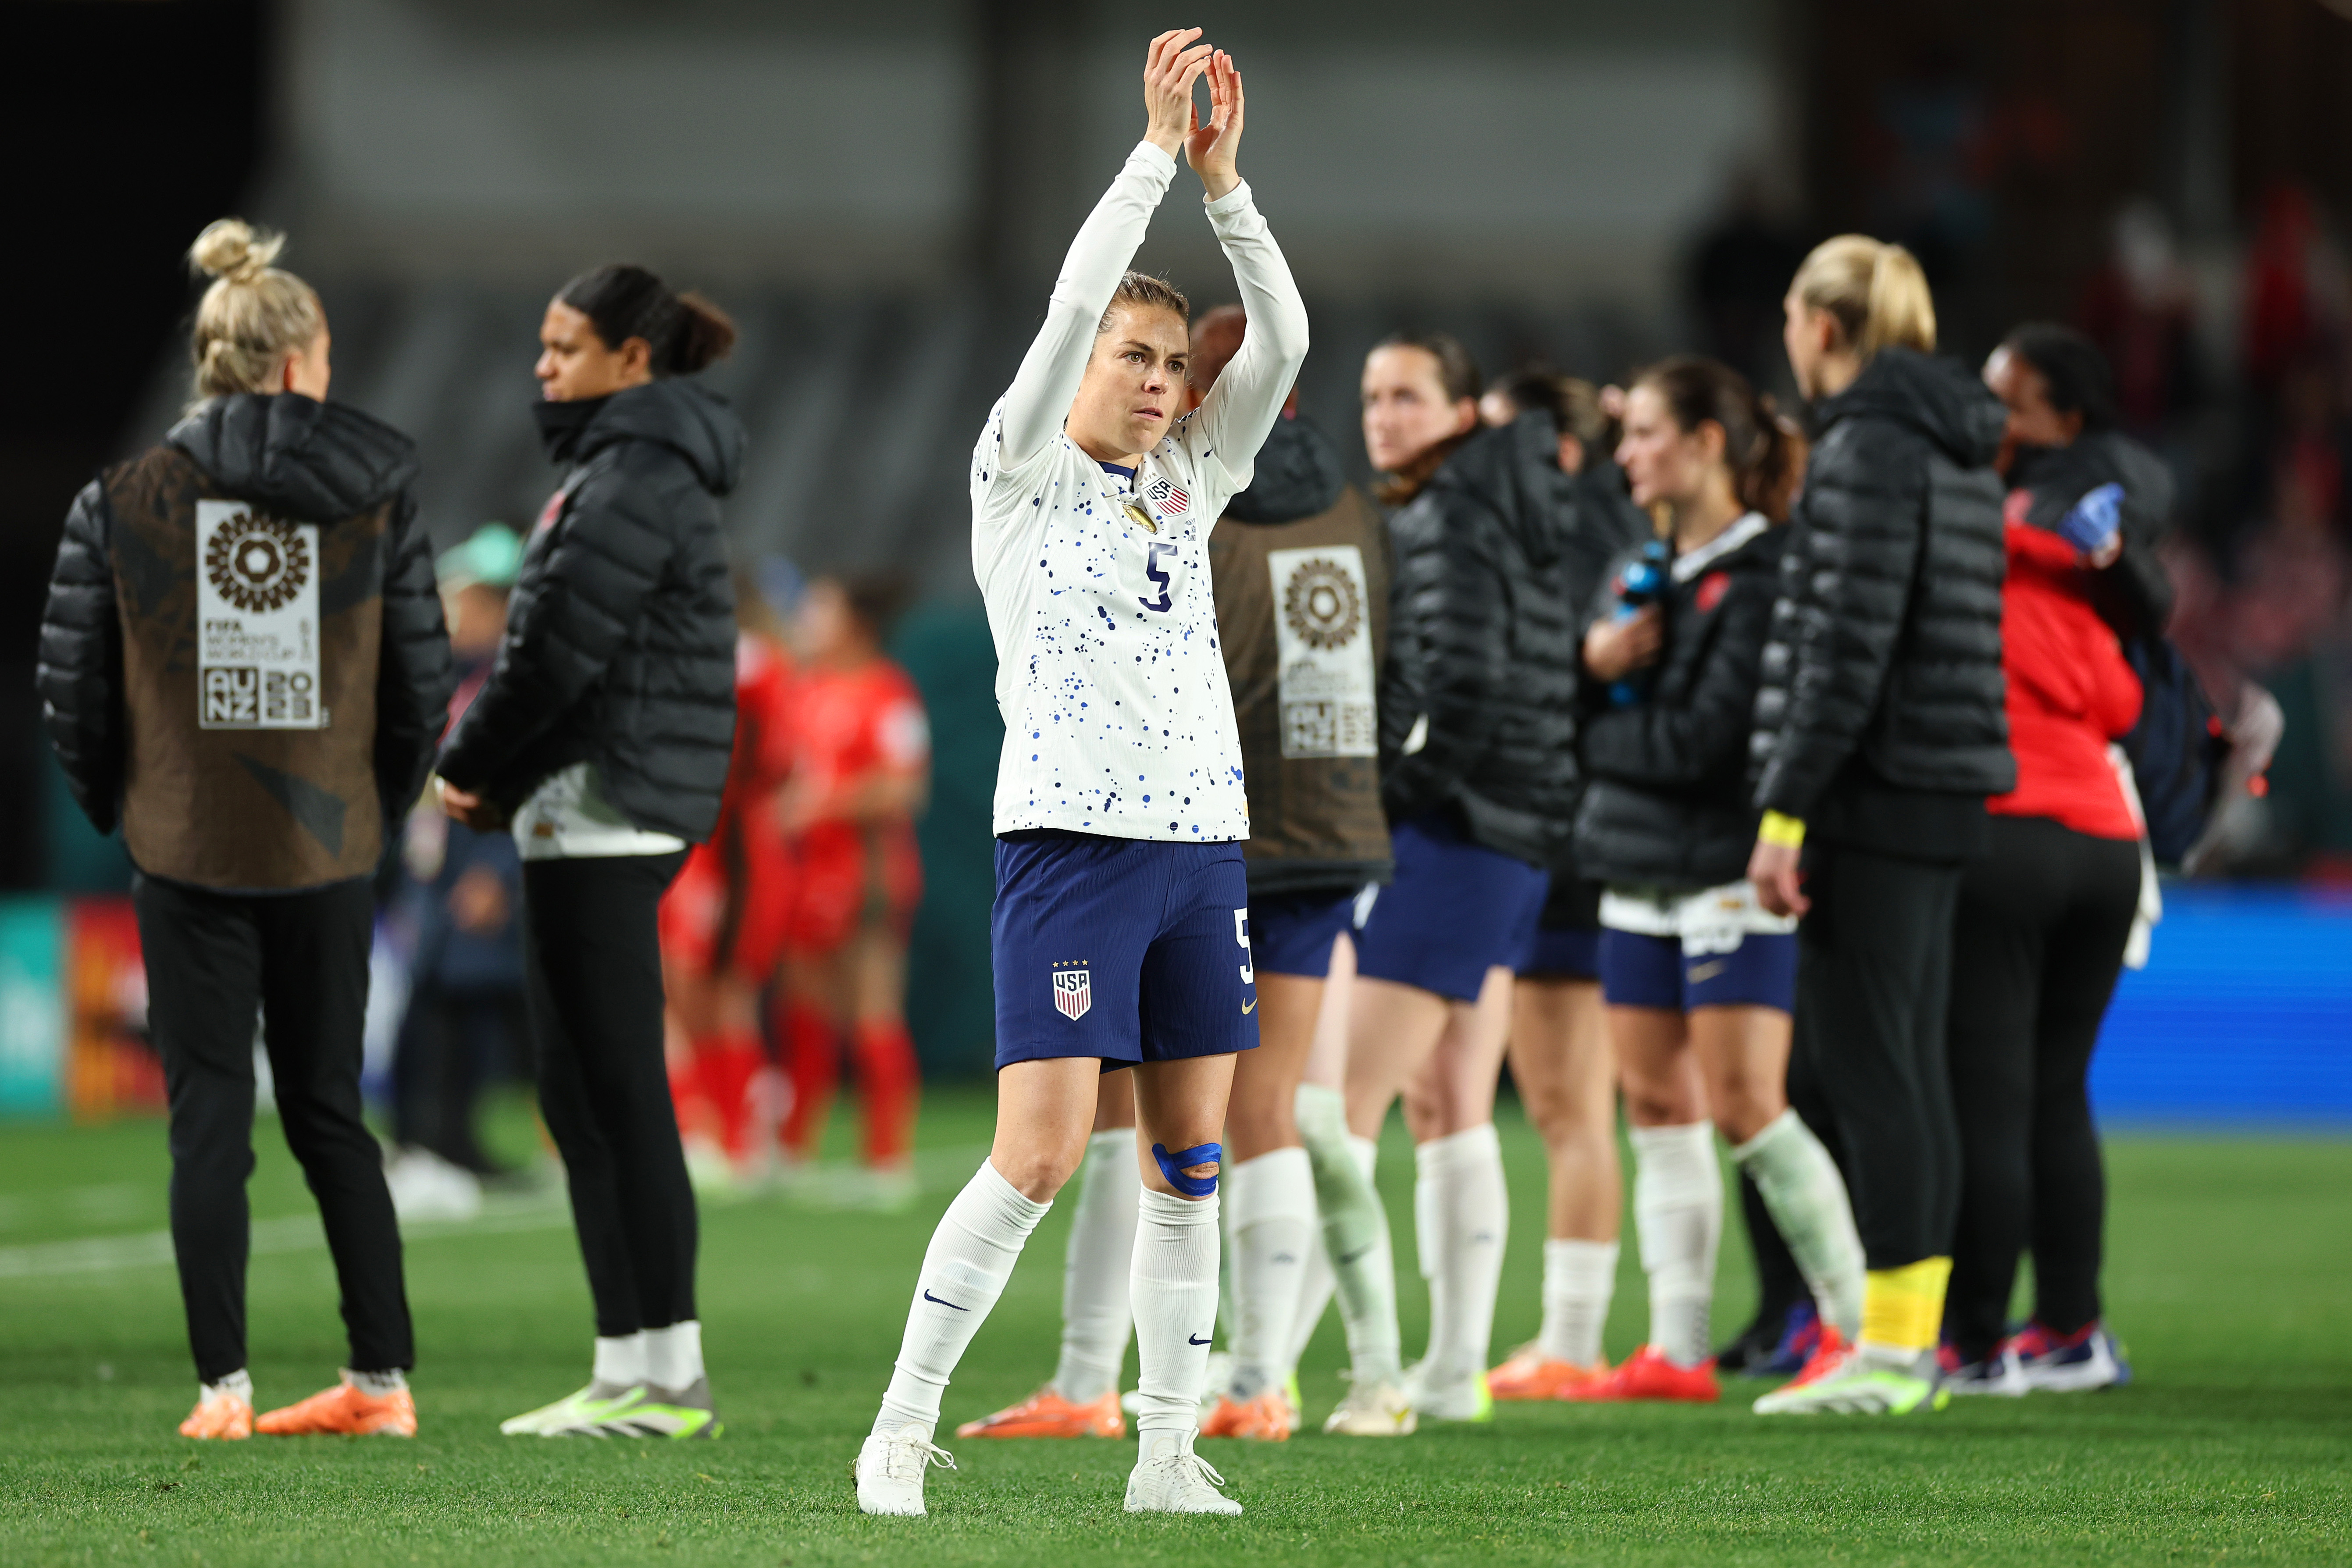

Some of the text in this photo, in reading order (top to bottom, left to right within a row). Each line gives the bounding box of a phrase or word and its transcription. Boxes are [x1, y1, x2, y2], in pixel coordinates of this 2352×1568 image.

[1147, 481, 1171, 499] USA
[1138, 542, 1178, 612] 5
[206, 670, 256, 695] AU
[266, 671, 312, 694] 20
[207, 695, 256, 720] NZ
[1055, 973, 1087, 992] USA
